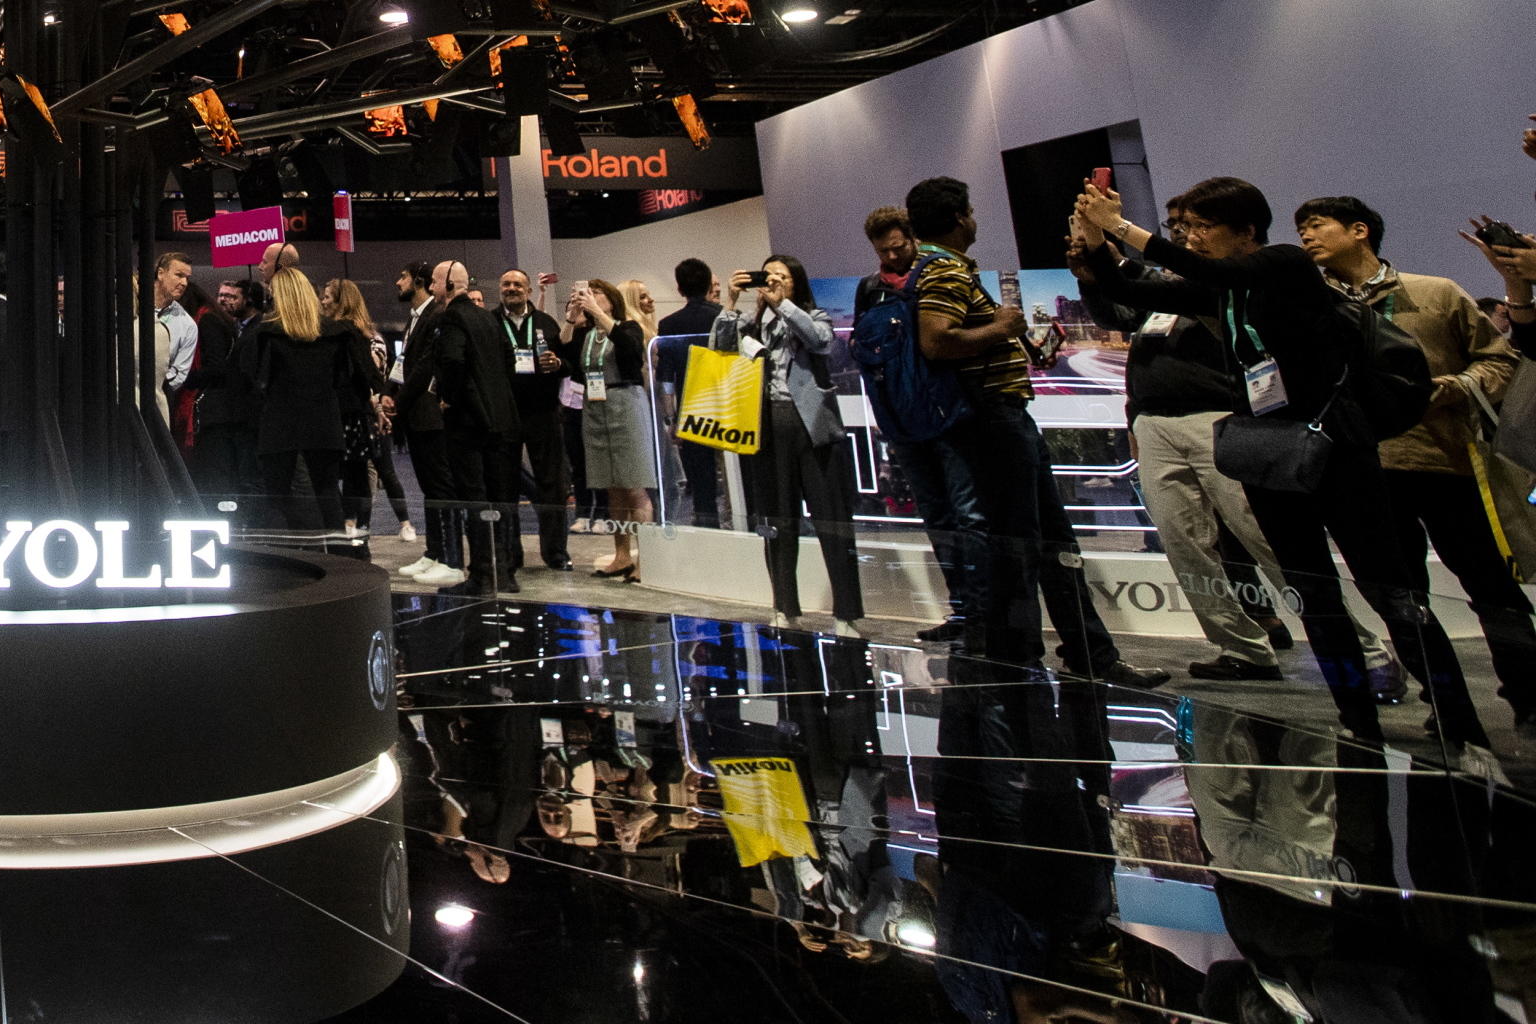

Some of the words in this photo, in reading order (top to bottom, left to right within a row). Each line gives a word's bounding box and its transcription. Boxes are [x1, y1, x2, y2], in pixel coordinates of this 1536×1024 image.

[541, 148, 667, 178] Roland
[215, 228, 278, 247] MEDIACOM
[682, 414, 756, 445] Nikon
